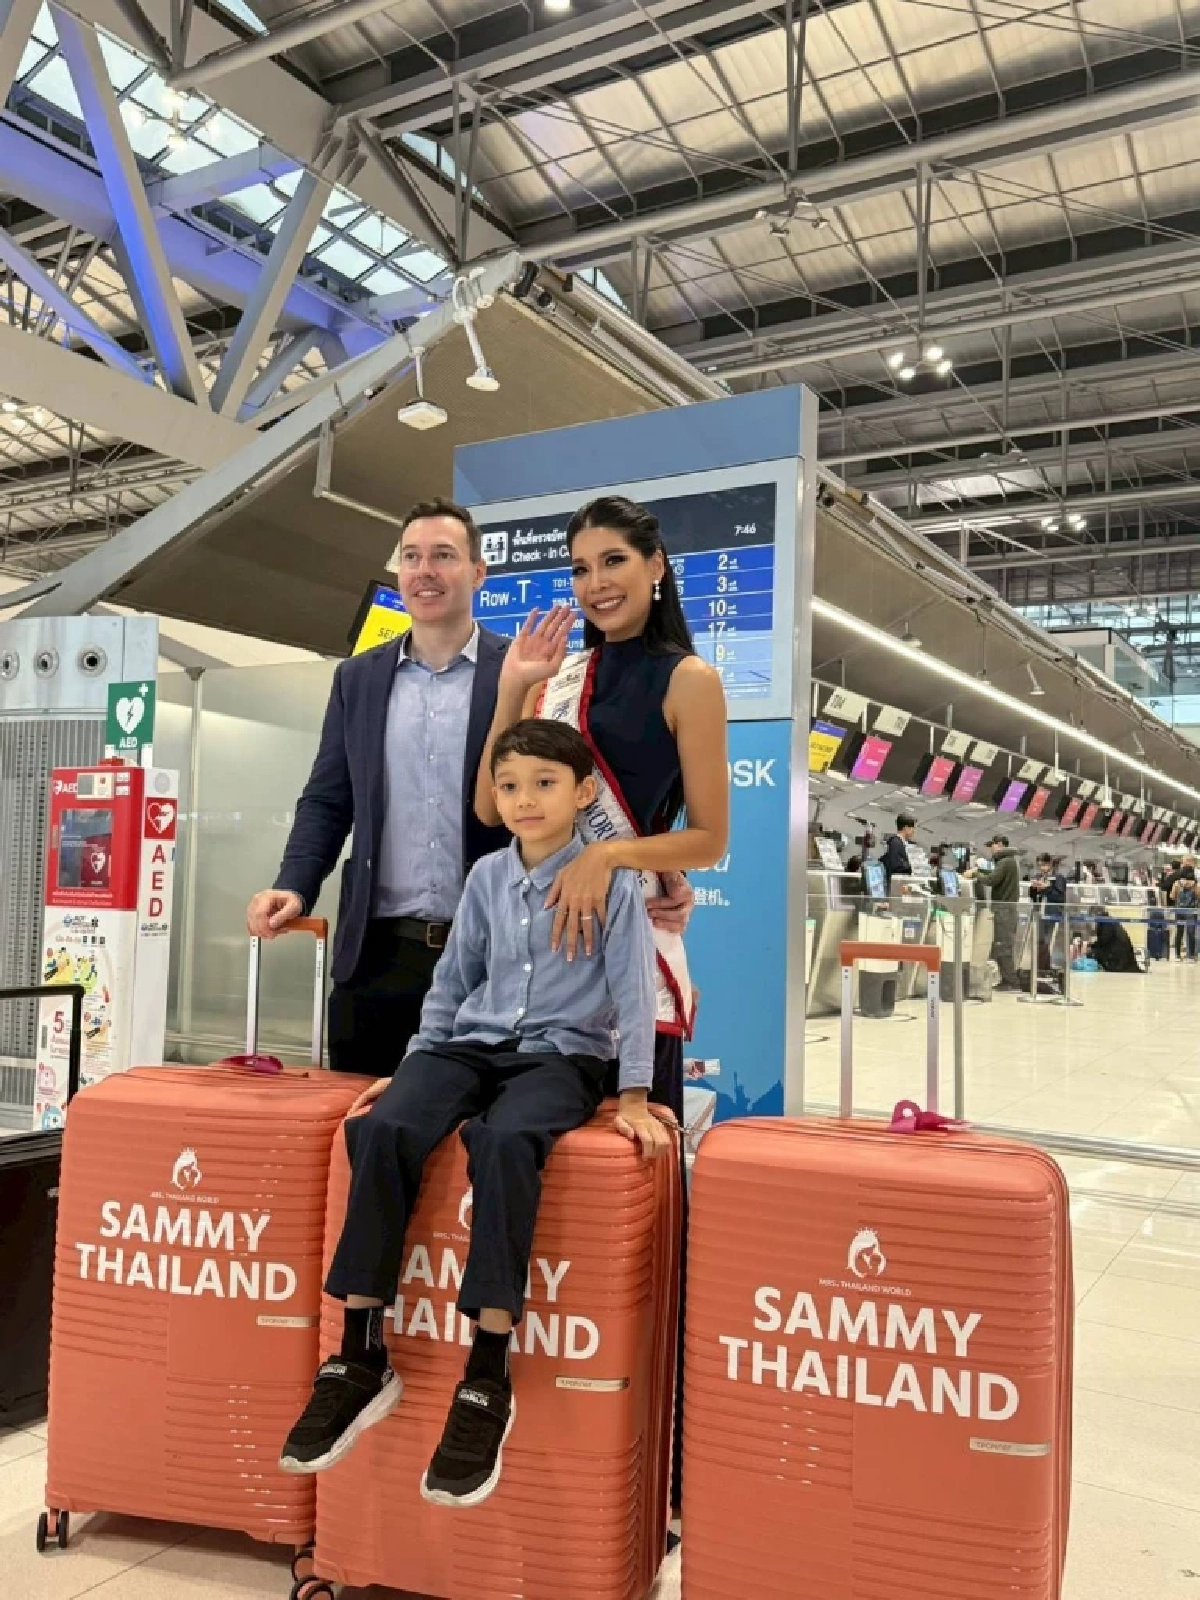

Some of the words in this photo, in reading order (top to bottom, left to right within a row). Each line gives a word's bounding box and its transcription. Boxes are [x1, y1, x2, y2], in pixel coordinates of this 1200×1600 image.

[733, 523, 757, 536] 7:46
[511, 550, 541, 563] Check
[718, 553, 728, 571] 2
[480, 590, 509, 606] Row
[517, 580, 531, 603] T
[716, 575, 728, 593] 3
[708, 599, 726, 616] 10
[708, 621, 726, 638] 17
[119, 736, 138, 748] AED
[727, 758, 776, 787] SK
[53, 1011, 65, 1034] 5
[100, 1199, 271, 1253] SAMMY
[75, 1241, 298, 1301] THAILAND
[840, 1280, 880, 1293] THAILAND
[881, 1286, 912, 1296] WORLD
[754, 1286, 983, 1358] SAMMY
[719, 1335, 1020, 1421] THAILAND
